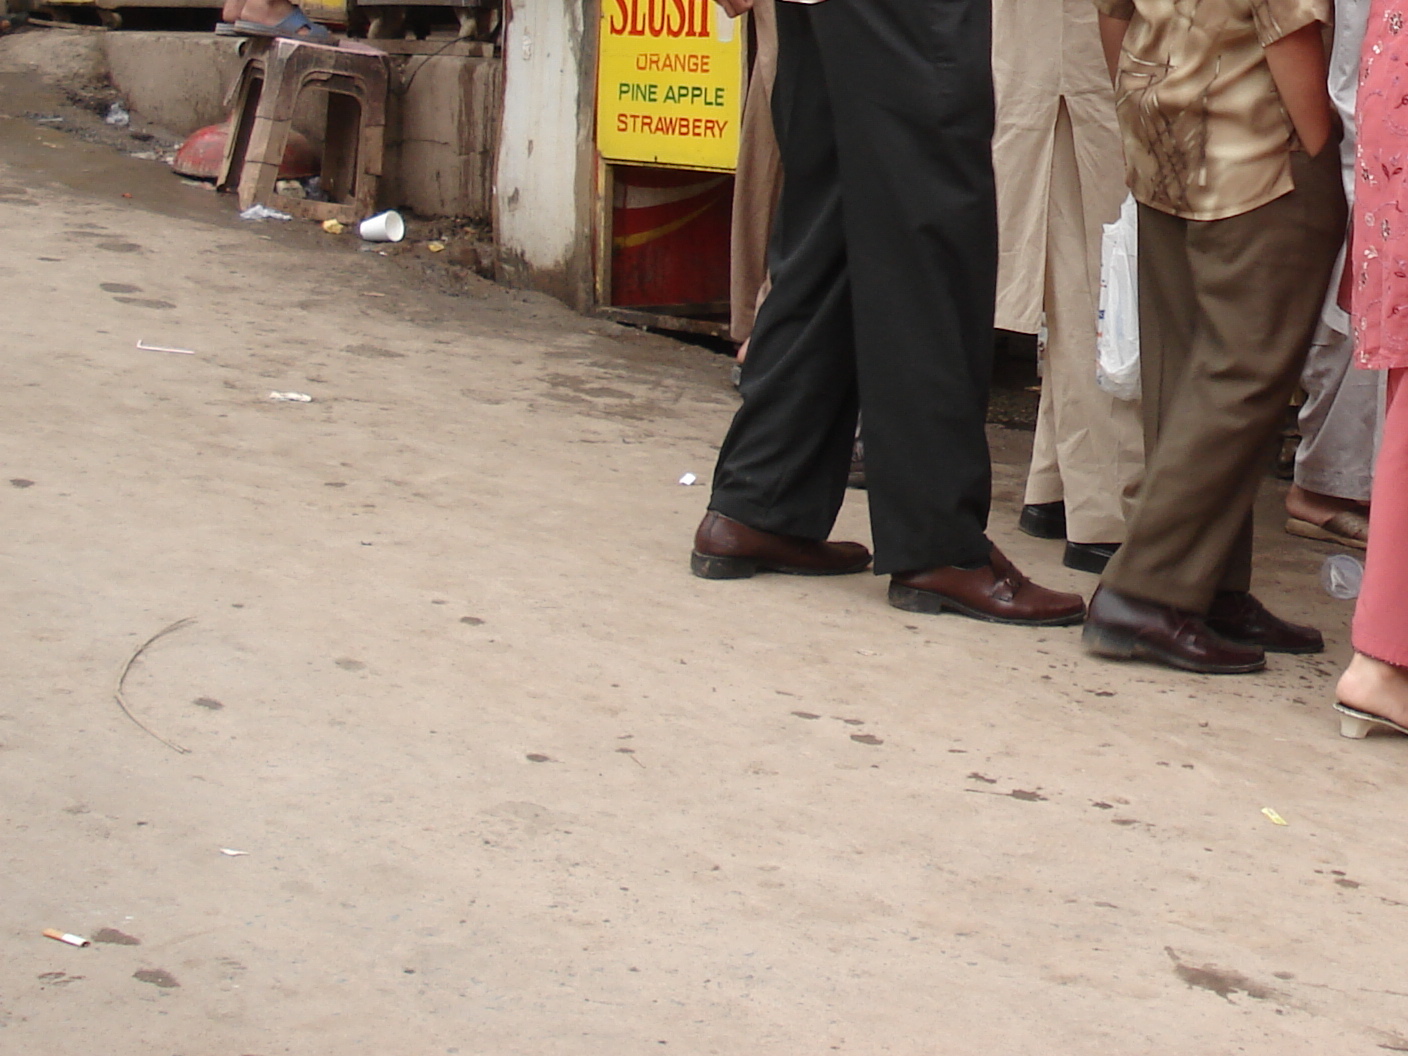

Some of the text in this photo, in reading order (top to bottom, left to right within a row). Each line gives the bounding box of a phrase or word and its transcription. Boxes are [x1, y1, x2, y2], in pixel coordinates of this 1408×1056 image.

[636, 53, 711, 73] ORANGE
[618, 82, 725, 107] PINE APPLE
[617, 113, 729, 139] STRAWBERY
